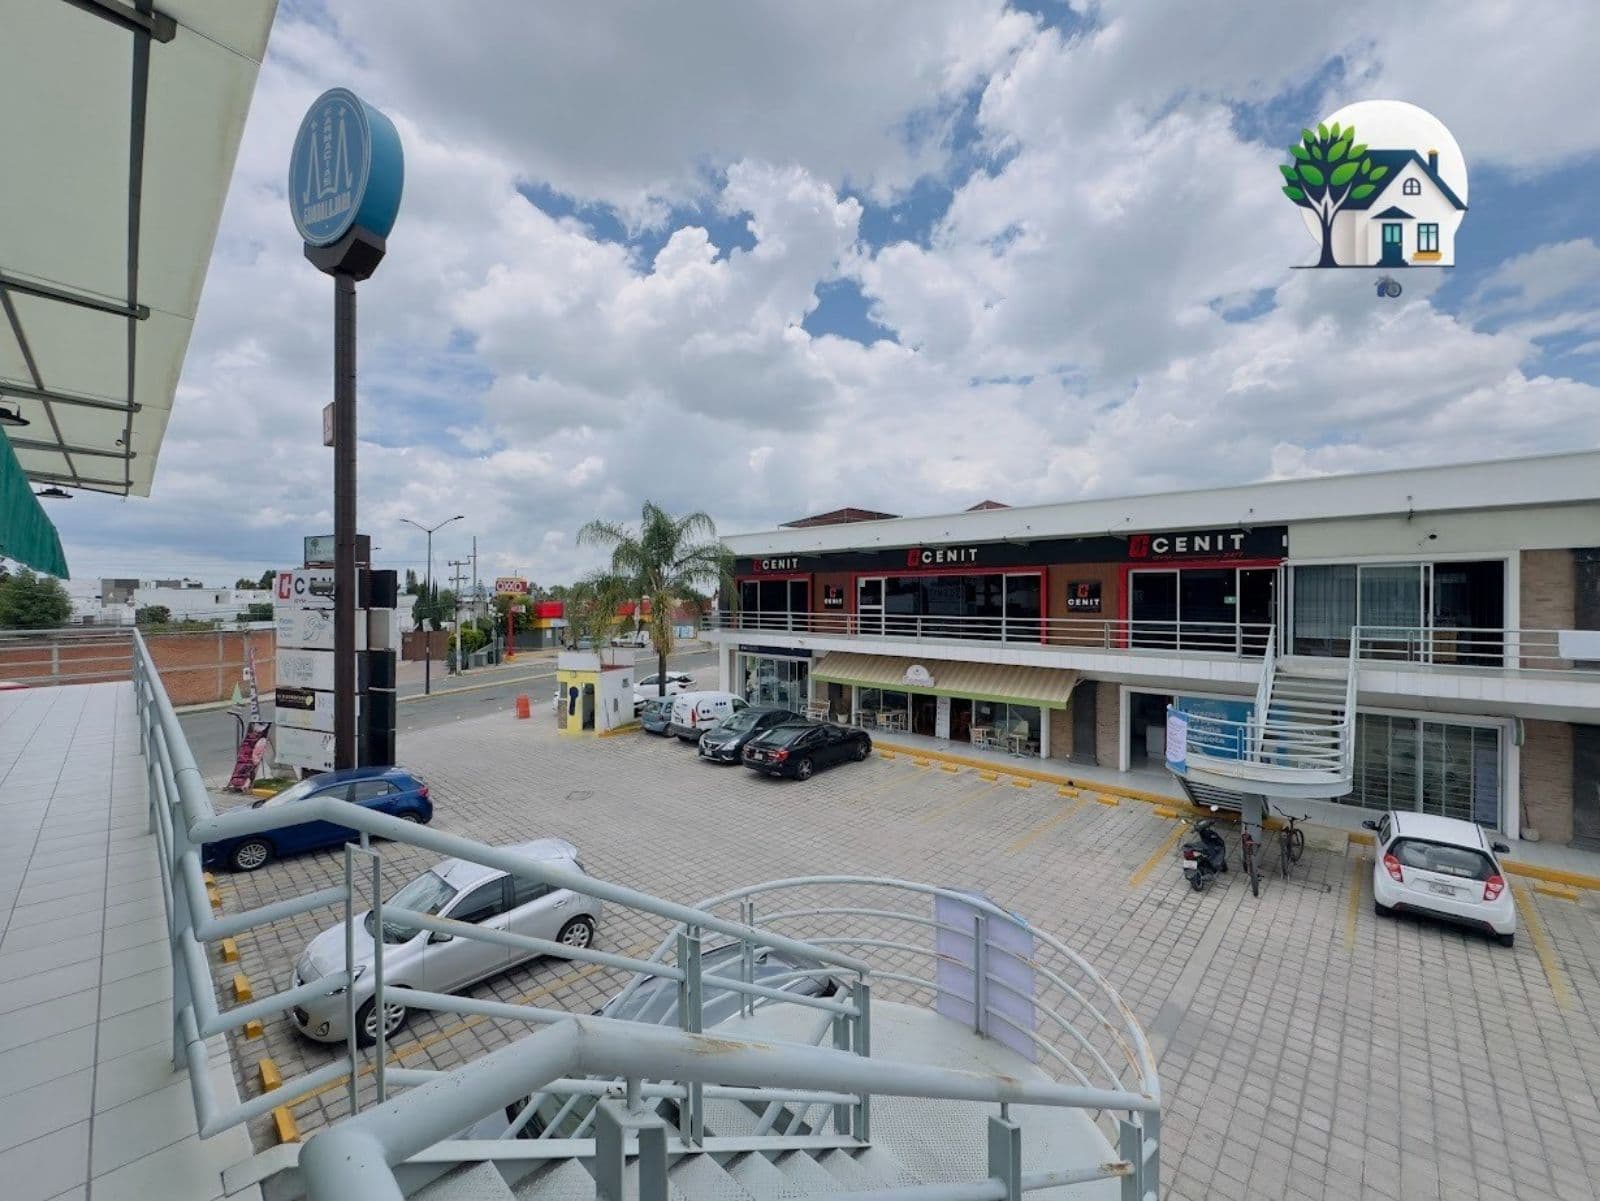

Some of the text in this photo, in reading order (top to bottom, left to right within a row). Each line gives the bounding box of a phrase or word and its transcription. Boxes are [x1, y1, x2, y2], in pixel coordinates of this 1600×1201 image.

[1152, 533, 1244, 553] CENIT
[922, 548, 978, 564] CENIT
[762, 557, 798, 570] CENIT
[496, 581, 522, 592] OXXO
[1067, 598, 1100, 606] CENIT
